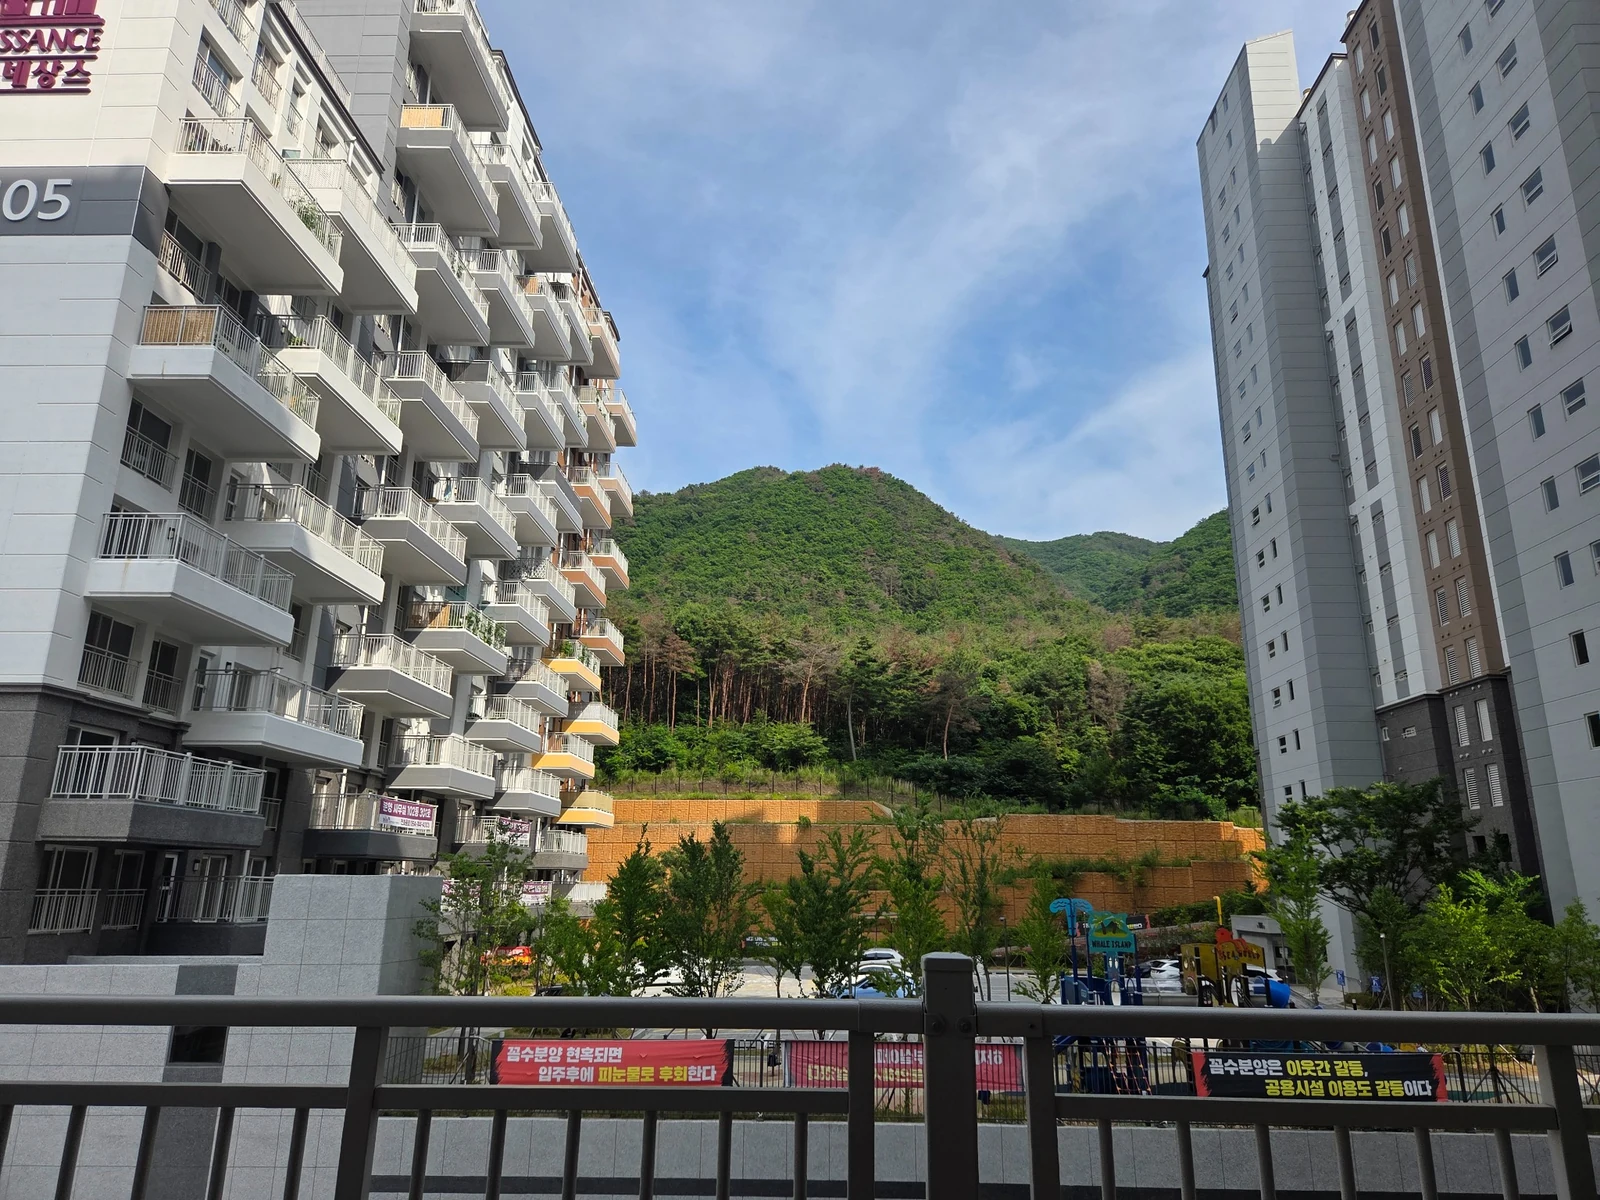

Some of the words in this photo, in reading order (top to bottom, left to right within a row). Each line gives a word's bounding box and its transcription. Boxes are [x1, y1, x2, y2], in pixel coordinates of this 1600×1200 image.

[0, 178, 73, 222] 05
[1092, 940, 1110, 949] WHALE
[1112, 940, 1132, 949] ISLAND
[507, 1046, 563, 1063] 꼼수분양
[566, 1046, 622, 1063] 현혹되면
[538, 1066, 594, 1082] 입주후에
[598, 1066, 655, 1083] 피눈물로
[659, 1065, 717, 1082] 후회한다
[1208, 1058, 1283, 1077] 꼼수분양은
[1286, 1060, 1331, 1077] 이웃간
[1265, 1079, 1325, 1097] 공용시설
[1328, 1080, 1373, 1098] 이용도
[1375, 1080, 1432, 1097] 갈등이다
